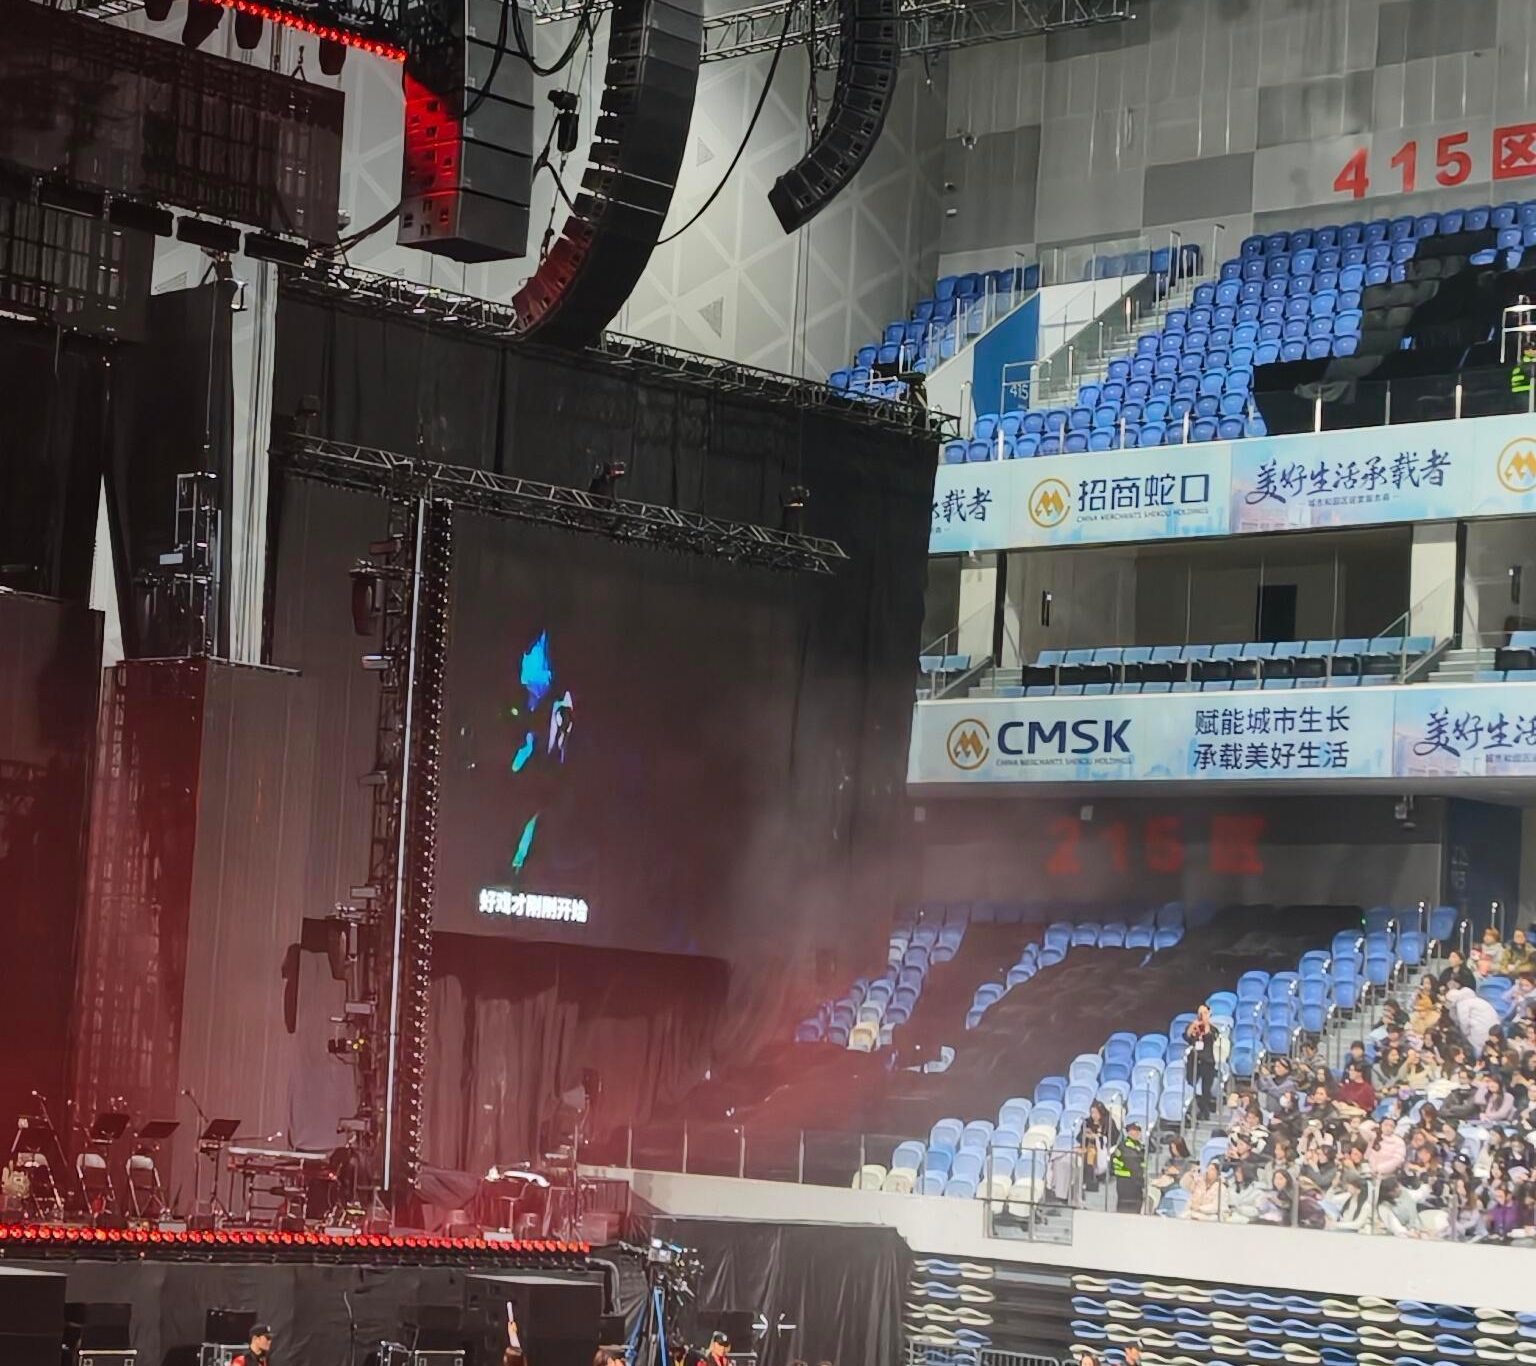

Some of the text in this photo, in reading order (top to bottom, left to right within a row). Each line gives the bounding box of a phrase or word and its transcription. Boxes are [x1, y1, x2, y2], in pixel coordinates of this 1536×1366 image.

[1077, 473, 1210, 513] 招商蛇口
[1245, 448, 1452, 505] 美好生活承载者
[996, 718, 1132, 755] CMSK
[1195, 704, 1351, 736] 赋能城市生长
[1193, 740, 1350, 771] 承载美好生活
